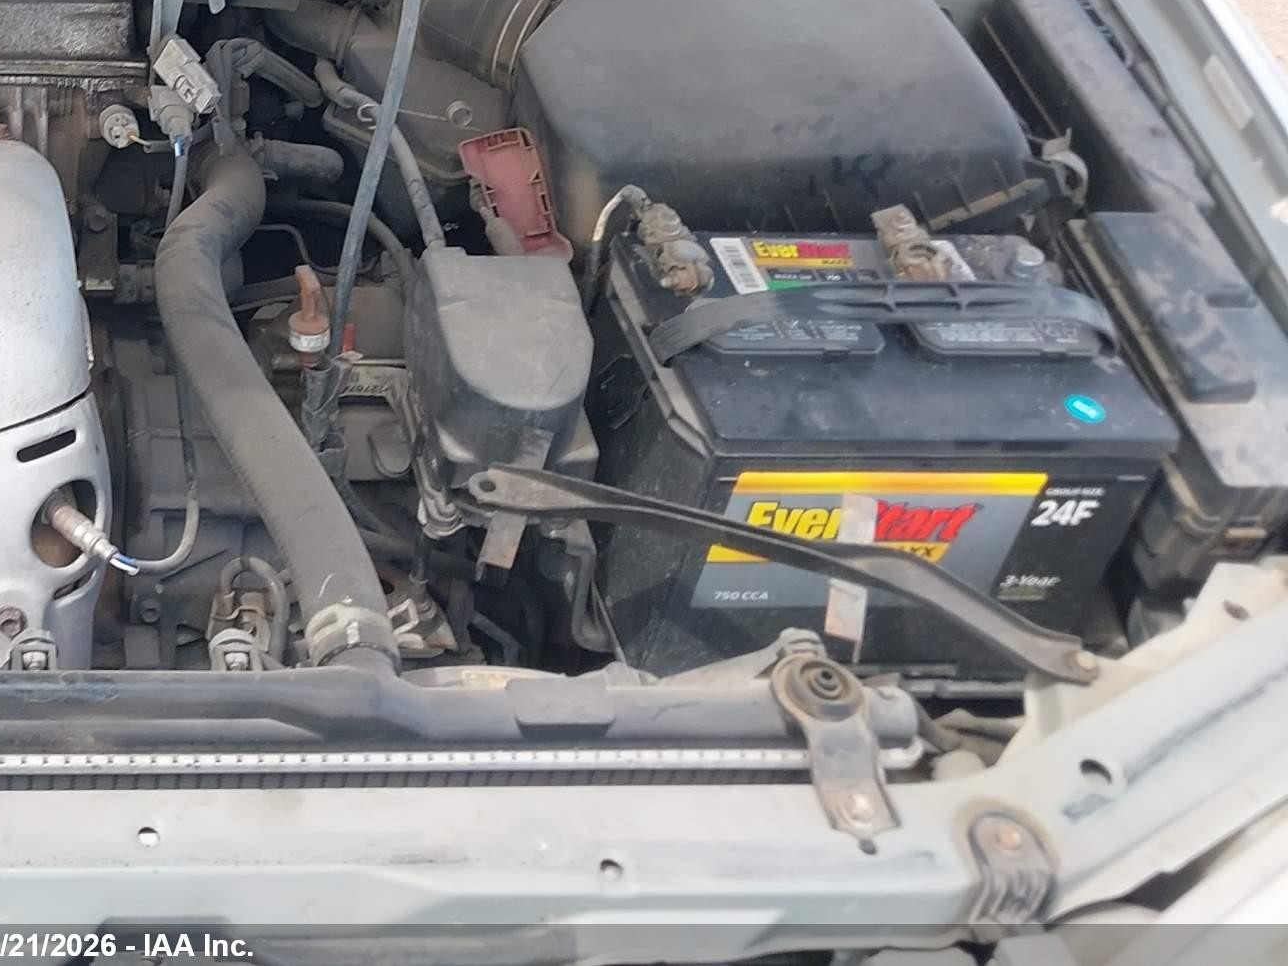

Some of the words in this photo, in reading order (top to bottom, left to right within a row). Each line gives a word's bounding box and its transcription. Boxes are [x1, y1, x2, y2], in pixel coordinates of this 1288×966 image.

[1030, 499, 1100, 526] 24F
[714, 590, 740, 601] 750
[741, 590, 769, 601] CCA
